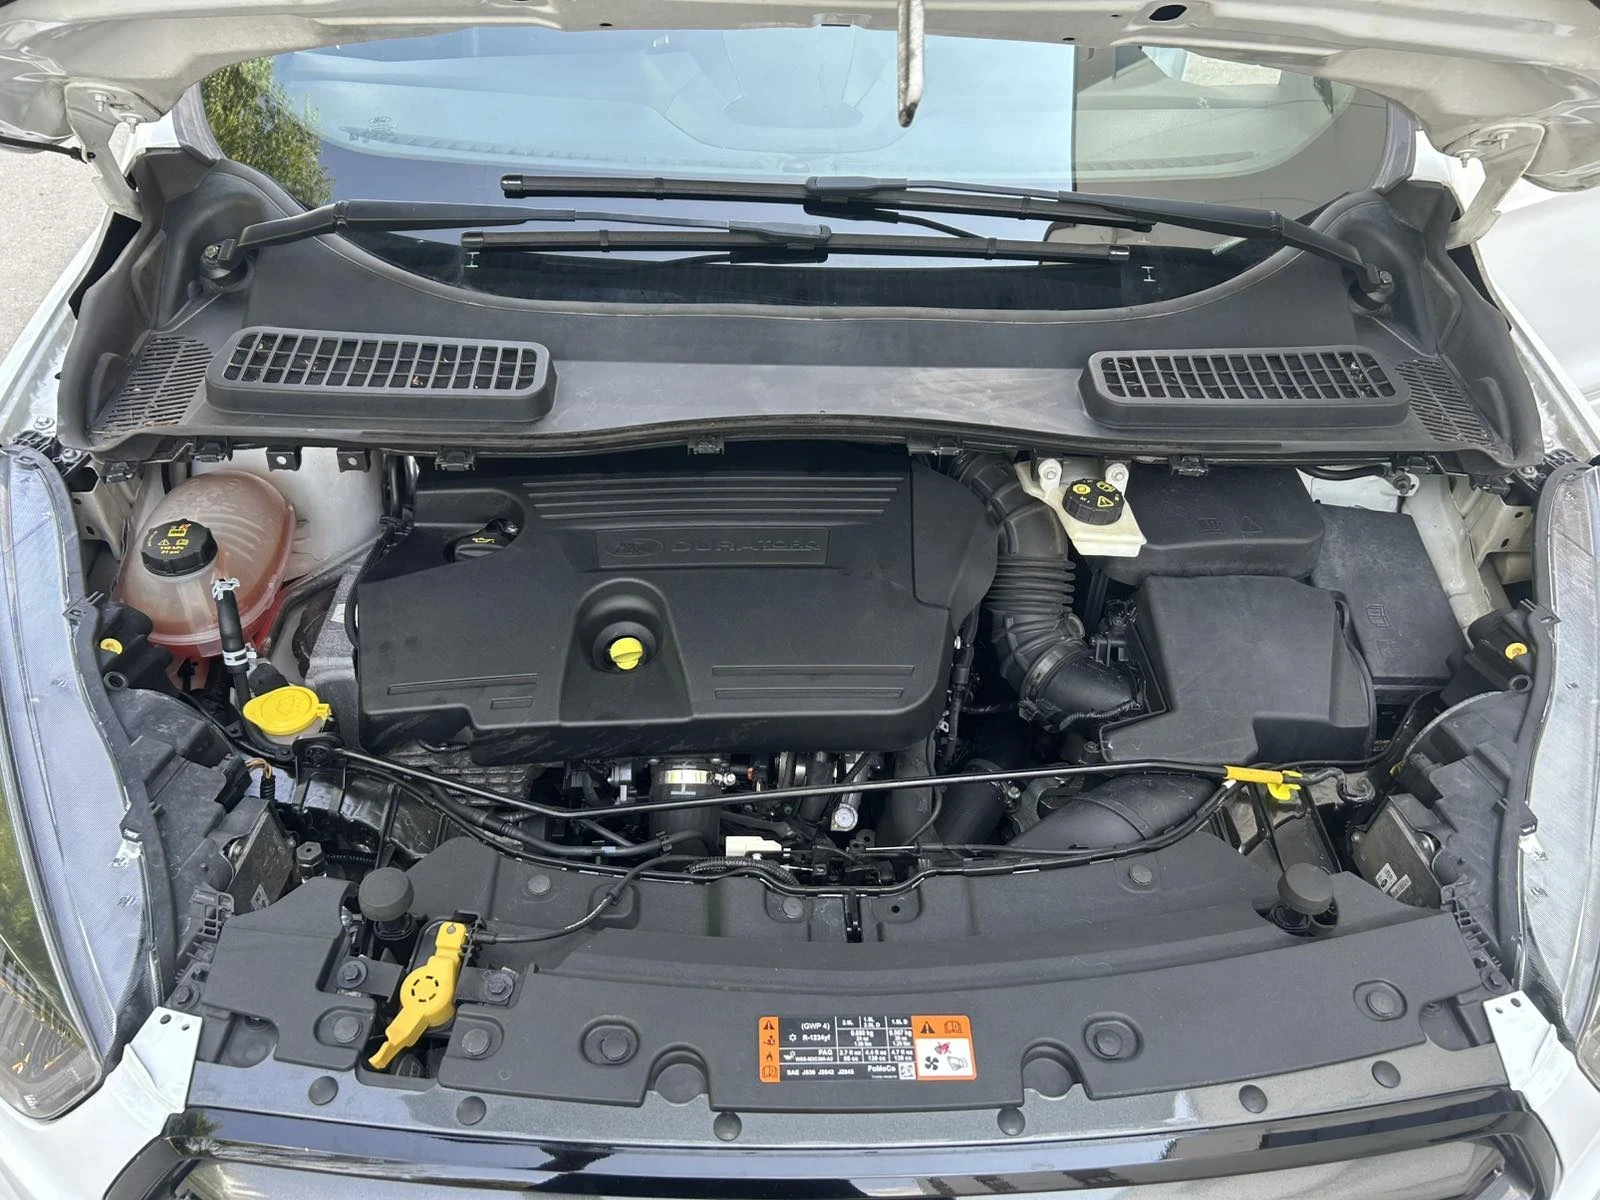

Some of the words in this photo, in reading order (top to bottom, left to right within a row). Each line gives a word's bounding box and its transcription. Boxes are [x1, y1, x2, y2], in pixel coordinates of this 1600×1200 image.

[801, 1023, 822, 1031] (GWP
[822, 1022, 830, 1030] 4)
[802, 1034, 831, 1042] R-1234yf
